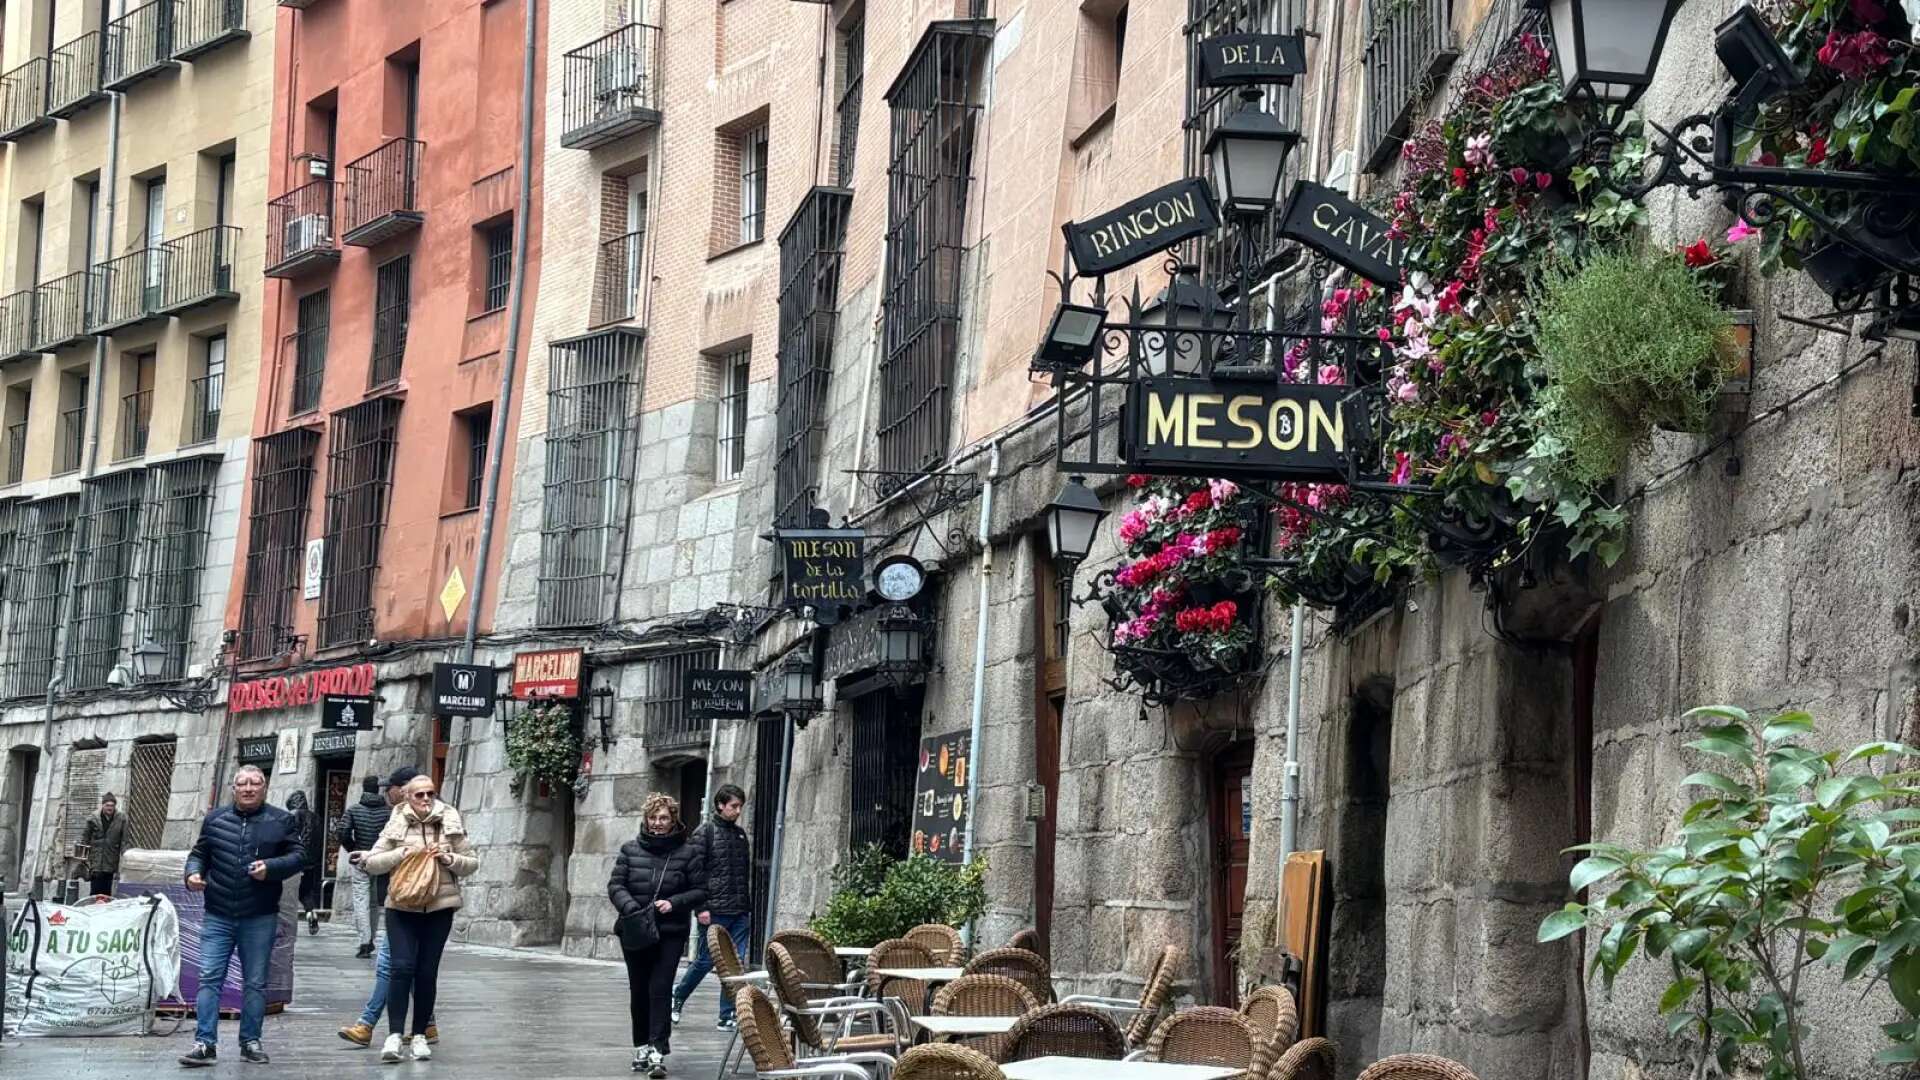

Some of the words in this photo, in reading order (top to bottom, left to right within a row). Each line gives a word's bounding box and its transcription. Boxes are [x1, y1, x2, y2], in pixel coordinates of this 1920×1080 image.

[1222, 45, 1250, 65] DE
[1255, 44, 1285, 65] LA
[1090, 192, 1195, 258] RINCON
[1313, 203, 1393, 266] CAVA
[1147, 392, 1344, 452] MESON
[826, 560, 845, 577] la
[792, 581, 861, 599] tortilla
[515, 652, 579, 683] MARCELINO
[458, 674, 469, 689] M
[692, 679, 744, 692] MESON
[439, 695, 486, 707] MARCELINO
[46, 930, 58, 953] A
[66, 930, 91, 953] TU
[96, 928, 141, 953] SACO
